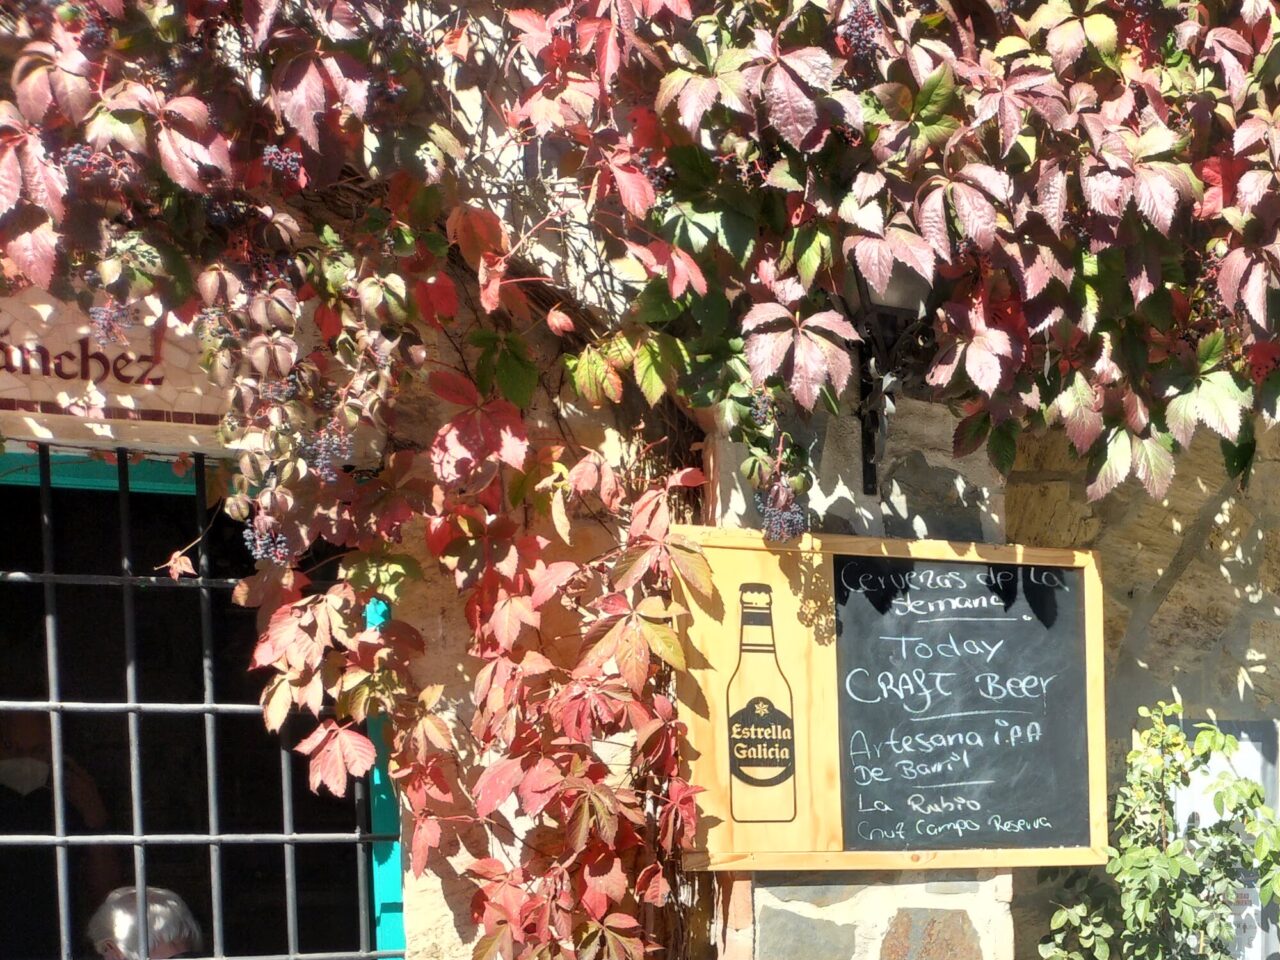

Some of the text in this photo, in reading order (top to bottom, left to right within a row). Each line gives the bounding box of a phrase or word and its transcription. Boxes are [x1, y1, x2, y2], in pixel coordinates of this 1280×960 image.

[879, 632, 1004, 663] Today
[974, 672, 1058, 704] Beer
[731, 723, 792, 740] Estrella
[734, 742, 790, 759] Galicia
[850, 727, 984, 766] Artesana
[853, 765, 892, 786] De
[858, 794, 893, 813] La
[915, 819, 981, 837] Campo
